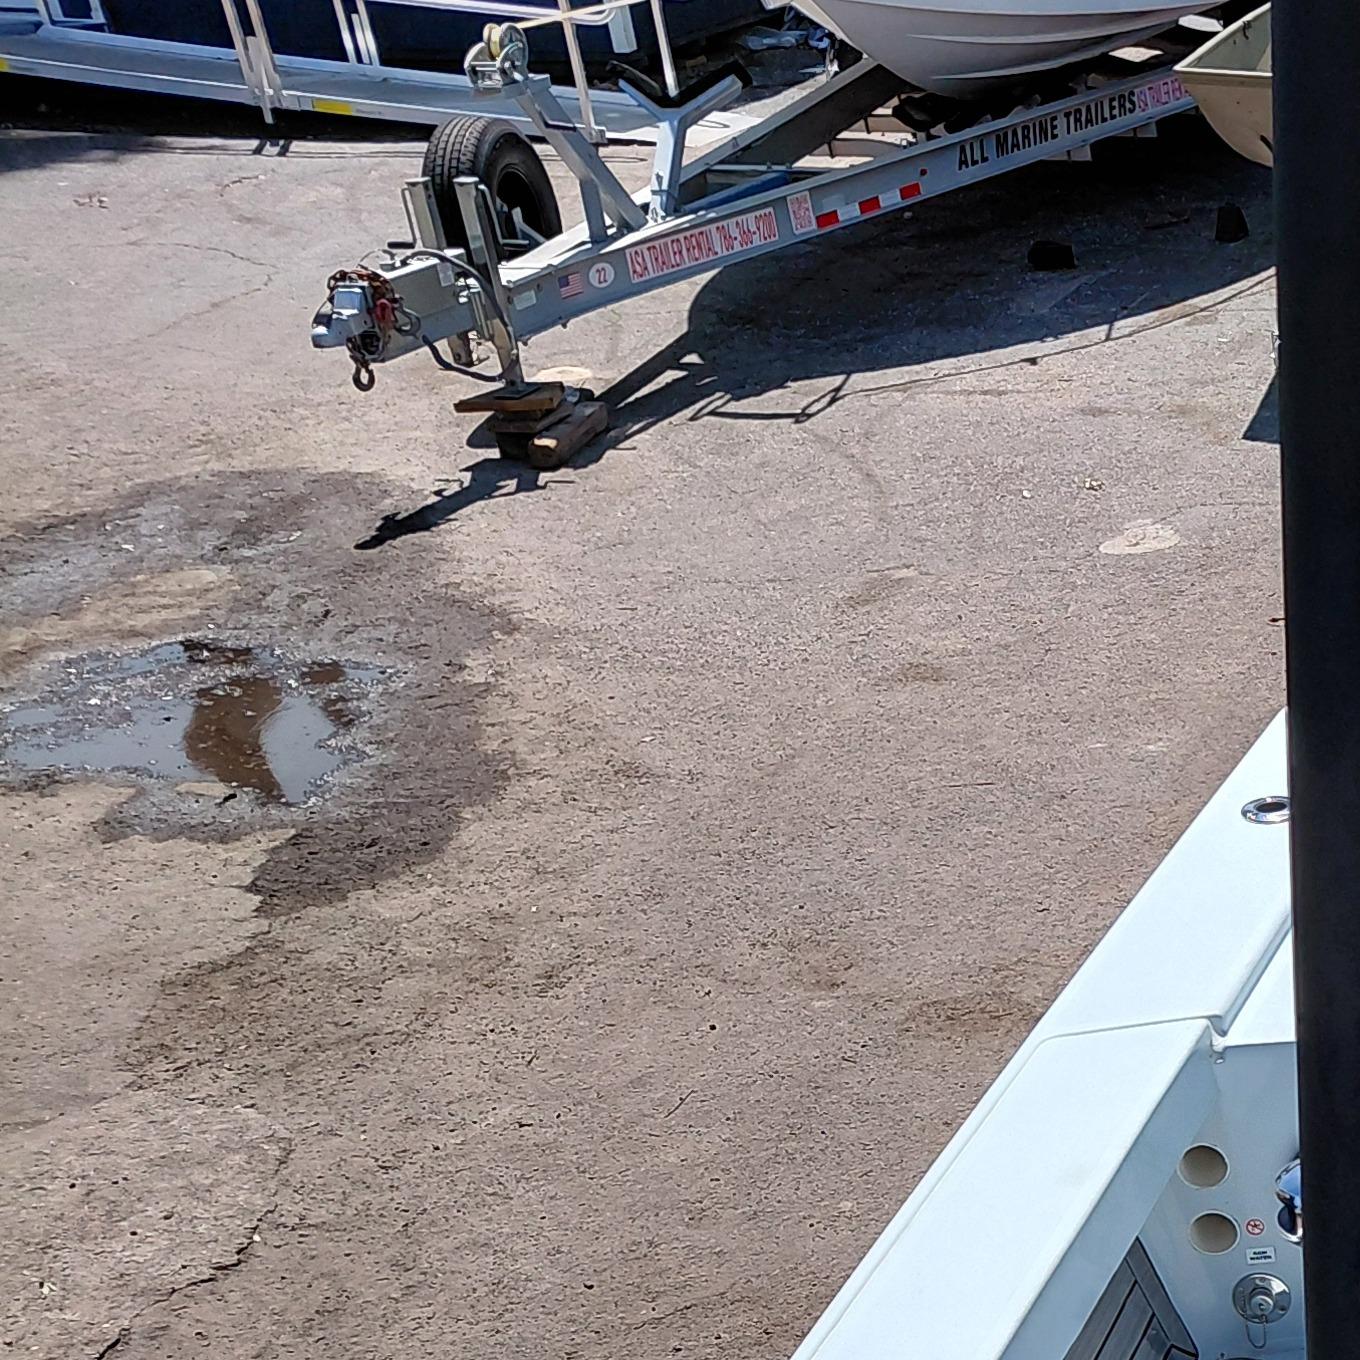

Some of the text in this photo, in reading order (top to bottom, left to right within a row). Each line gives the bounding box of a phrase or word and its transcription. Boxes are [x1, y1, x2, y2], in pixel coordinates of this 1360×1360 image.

[958, 140, 989, 171] ALL
[996, 116, 1059, 158] MARINE
[1064, 91, 1137, 135] TRAILERS
[596, 268, 608, 284] 22
[630, 212, 777, 279] ASA TRAILER RENTAL 786-366-9200
